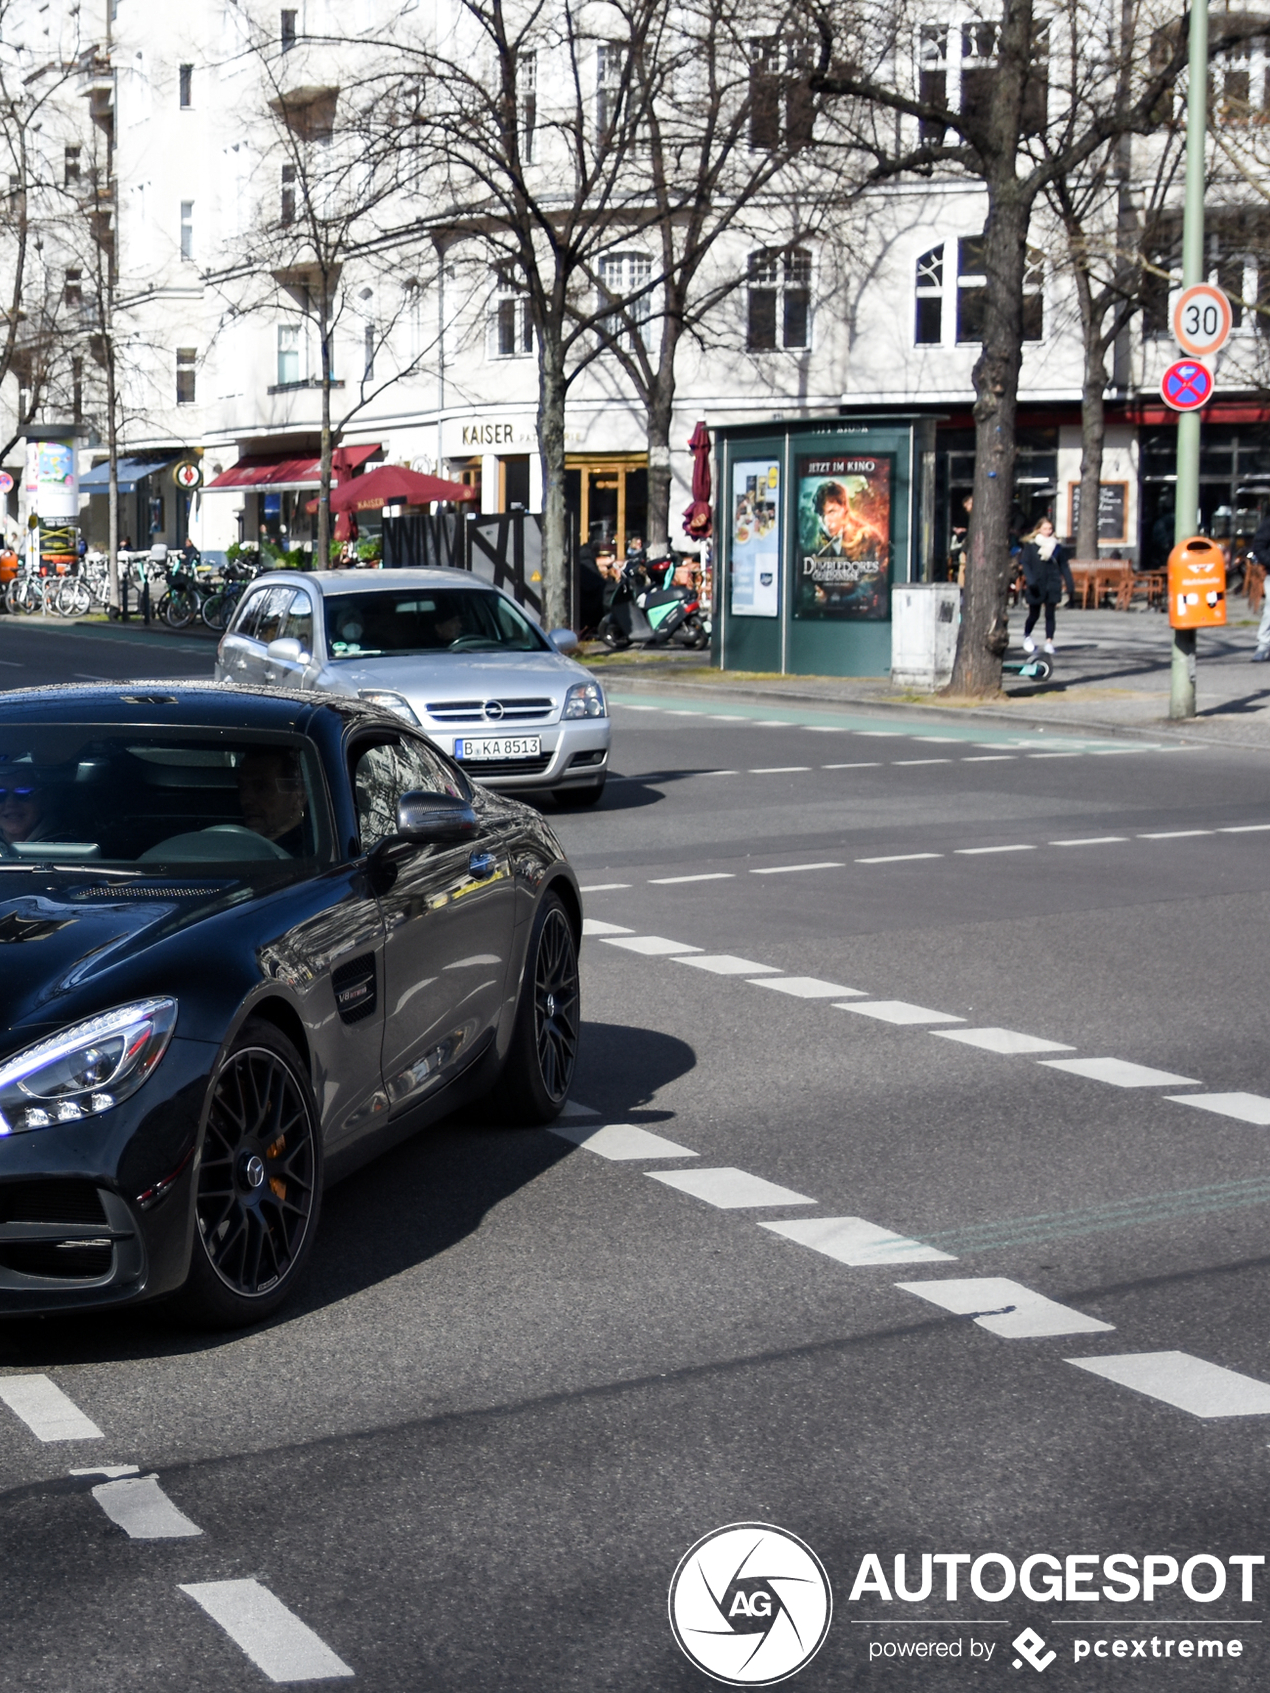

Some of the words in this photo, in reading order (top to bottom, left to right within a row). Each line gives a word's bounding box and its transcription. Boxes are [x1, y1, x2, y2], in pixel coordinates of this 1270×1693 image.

[1186, 305, 1218, 336] 30
[462, 424, 514, 445] KAISER
[519, 431, 581, 443] PATRIE
[808, 461, 831, 473] JETZT
[832, 461, 845, 472] IM
[846, 460, 875, 472] KINO
[357, 498, 385, 510] KAISER
[464, 742, 473, 755] B
[483, 741, 501, 755] KA
[504, 739, 538, 754] 8513
